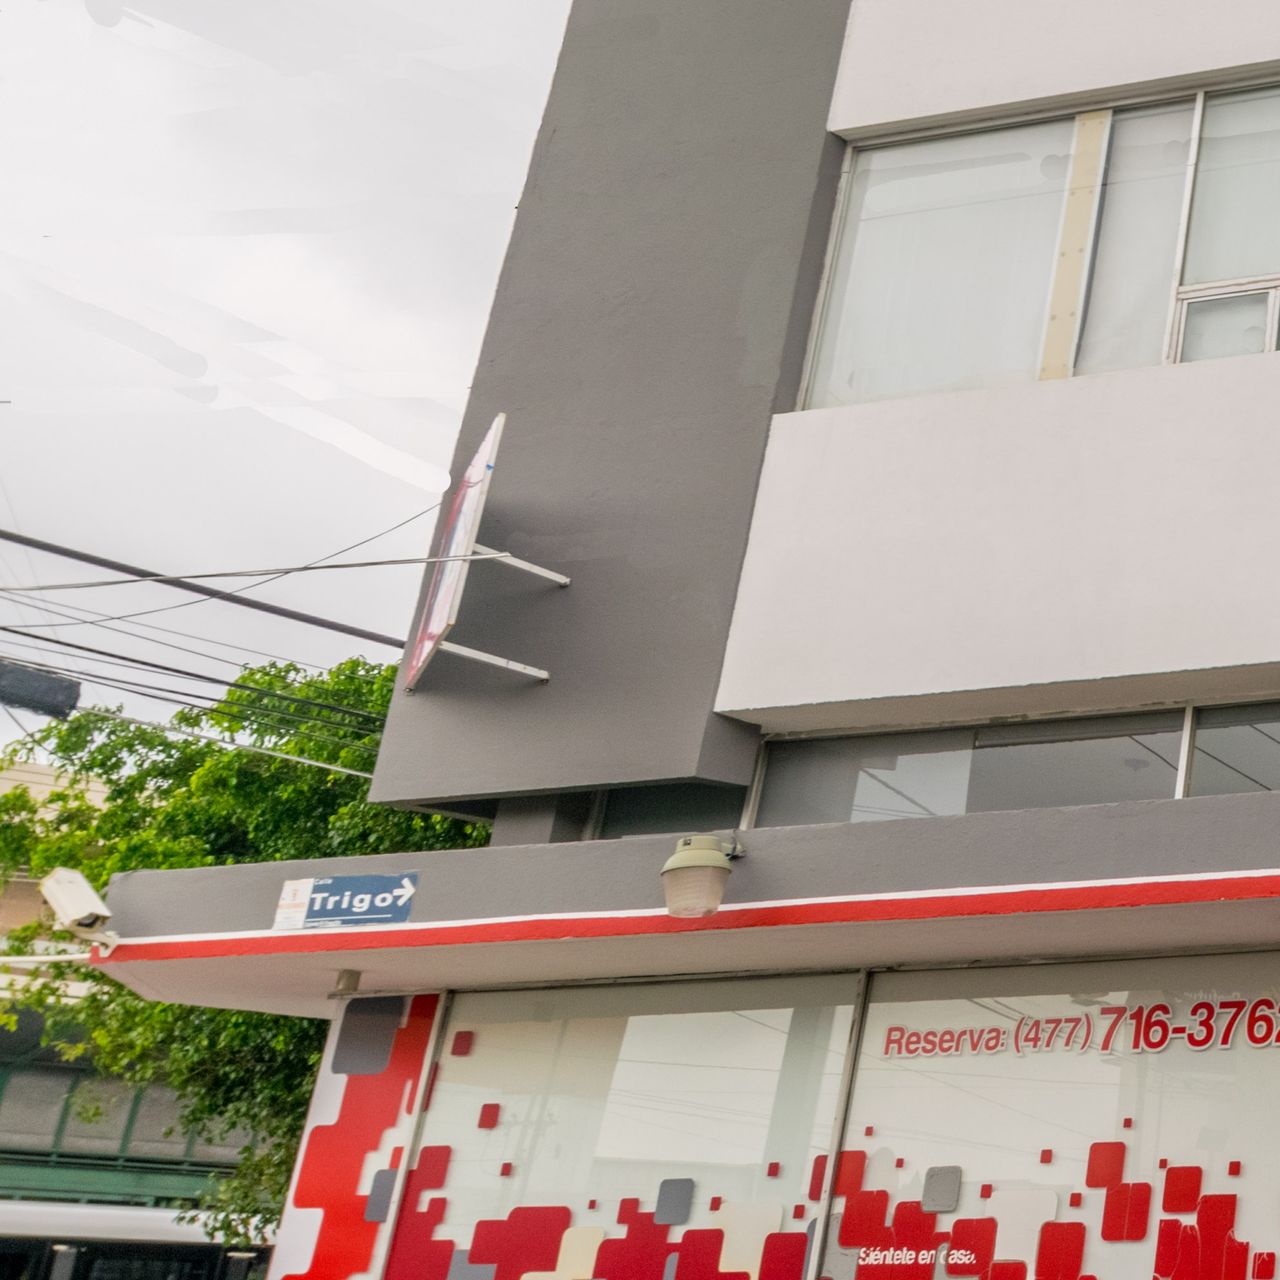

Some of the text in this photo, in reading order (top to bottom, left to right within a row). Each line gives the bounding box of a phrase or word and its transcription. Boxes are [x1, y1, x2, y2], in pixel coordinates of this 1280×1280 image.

[311, 891, 393, 912] Trigo
[884, 1025, 1007, 1057] Reserva:
[1014, 1013, 1093, 1054] (477)
[858, 1247, 916, 1265] Siéntete
[918, 1251, 936, 1264] en
